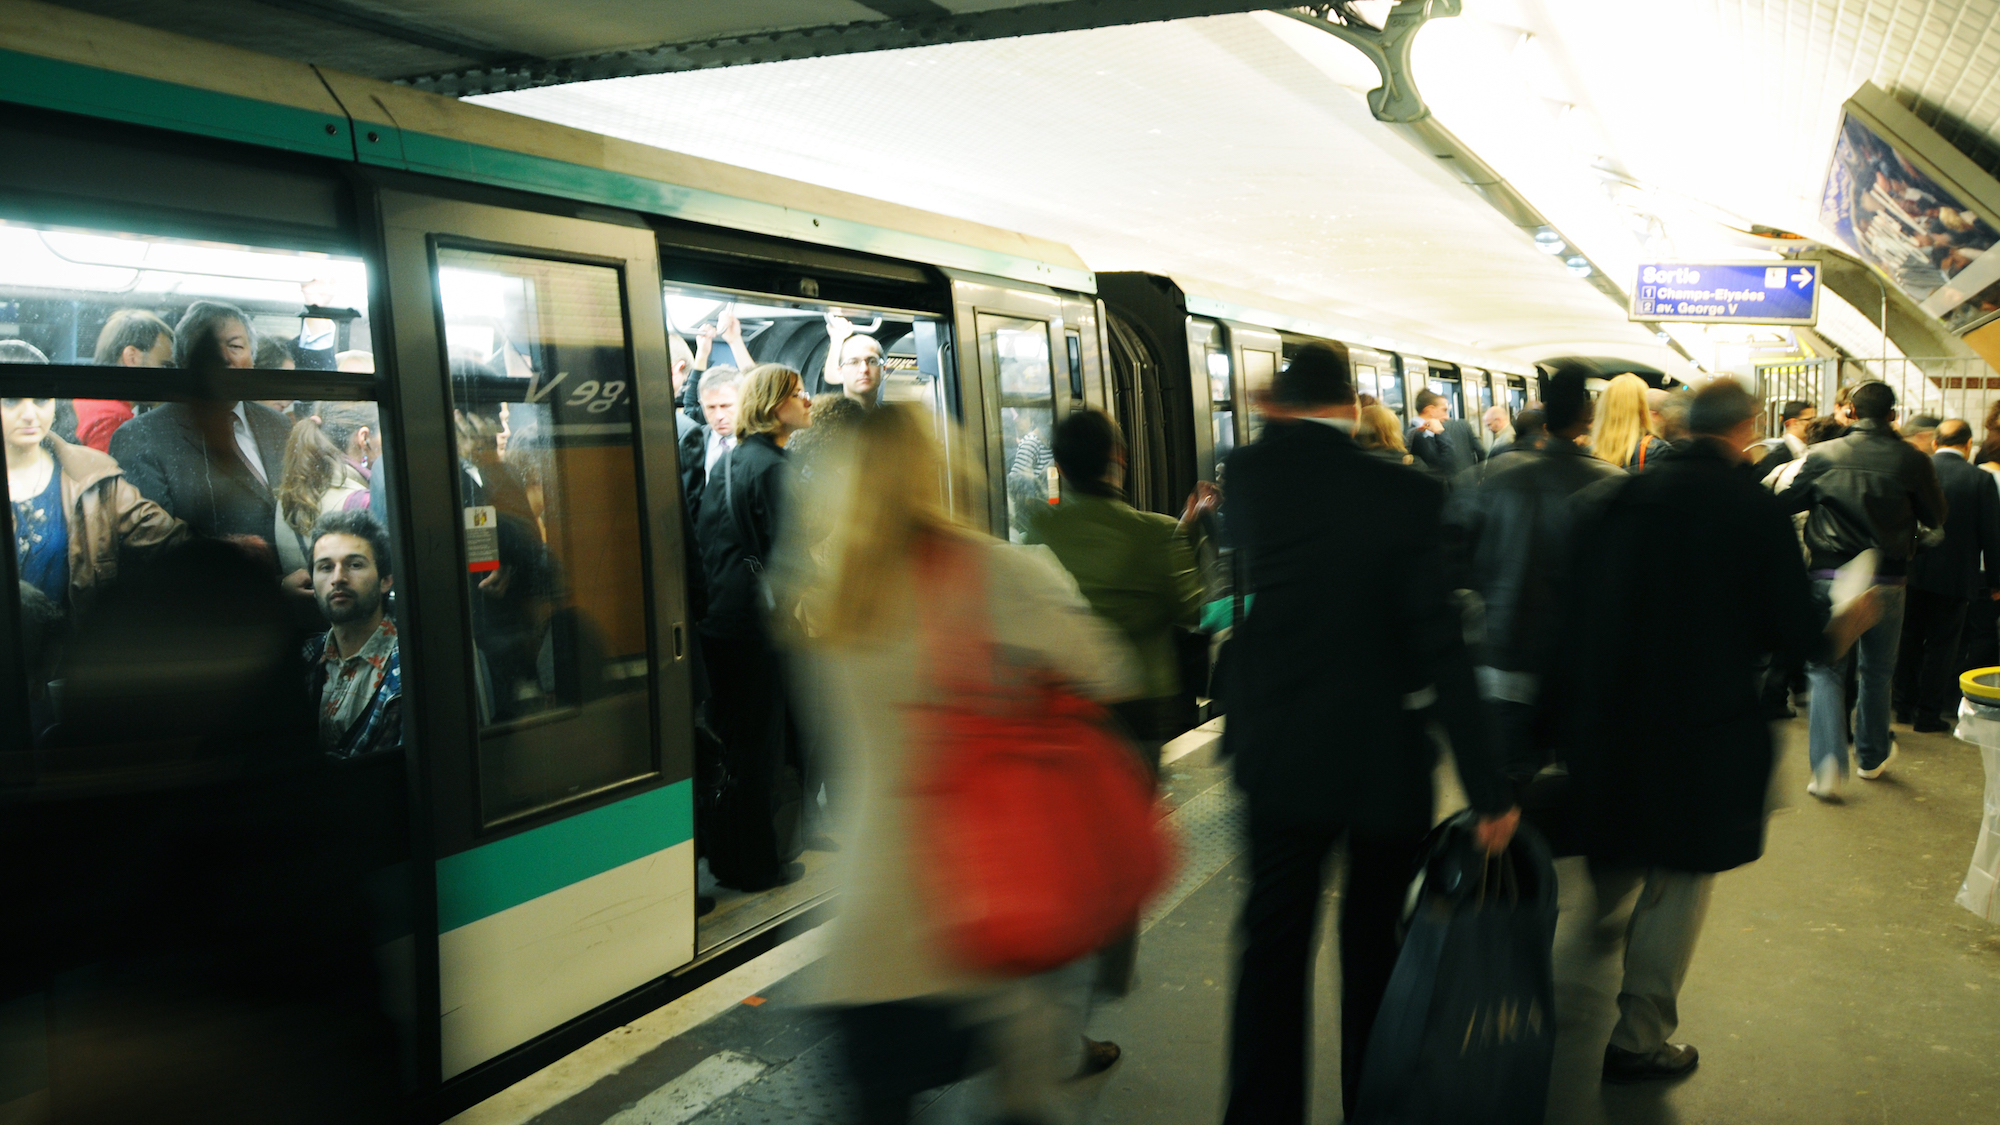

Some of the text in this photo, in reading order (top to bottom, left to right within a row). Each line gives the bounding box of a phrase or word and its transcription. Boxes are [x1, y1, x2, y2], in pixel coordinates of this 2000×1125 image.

[1642, 266, 1701, 285] Sortie
[1657, 287, 1766, 303] Champs-Elysées
[1656, 303, 1675, 314] av.
[1677, 302, 1726, 316] George
[1728, 303, 1739, 315] V
